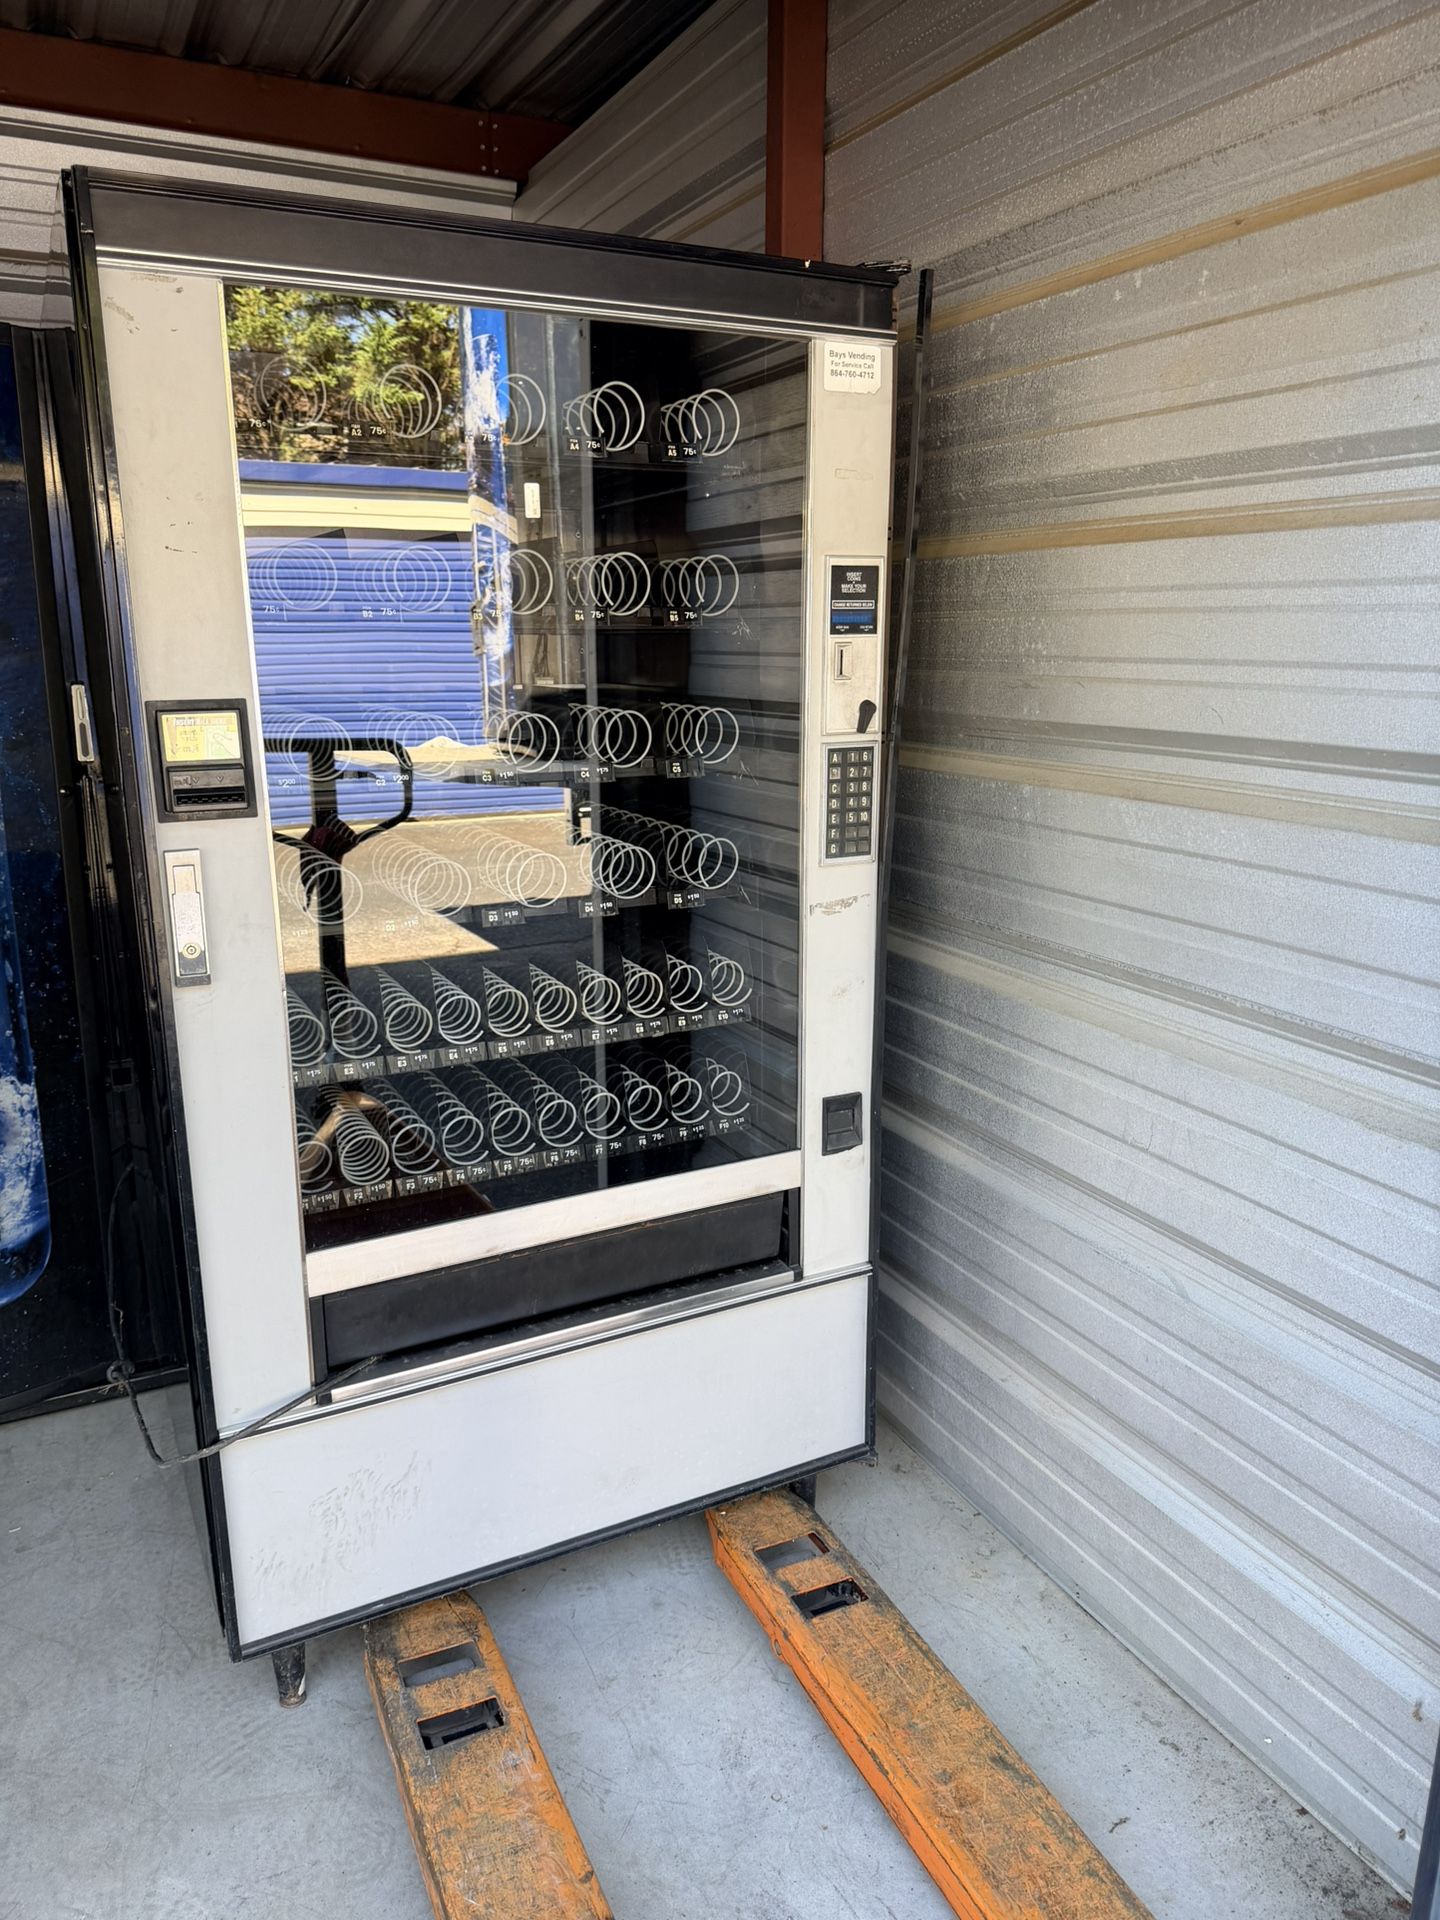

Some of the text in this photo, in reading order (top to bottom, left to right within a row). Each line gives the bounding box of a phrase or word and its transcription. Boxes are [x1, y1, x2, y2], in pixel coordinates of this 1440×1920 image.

[829, 349, 876, 362] Bays Vending
[842, 361, 862, 369] Service
[830, 369, 875, 379] 864-760-4712
[351, 428, 362, 437] A2
[570, 442, 579, 450] A4
[668, 449, 677, 457] A5
[832, 751, 868, 762] A 1 6
[849, 767, 855, 777] 2
[863, 767, 868, 776] 7
[832, 782, 867, 793] C 3 8
[831, 797, 867, 808] D 4 9
[831, 812, 868, 823] E 5 10
[831, 829, 836, 839] F
[830, 844, 836, 853] G
[488, 914, 498, 922] D3
